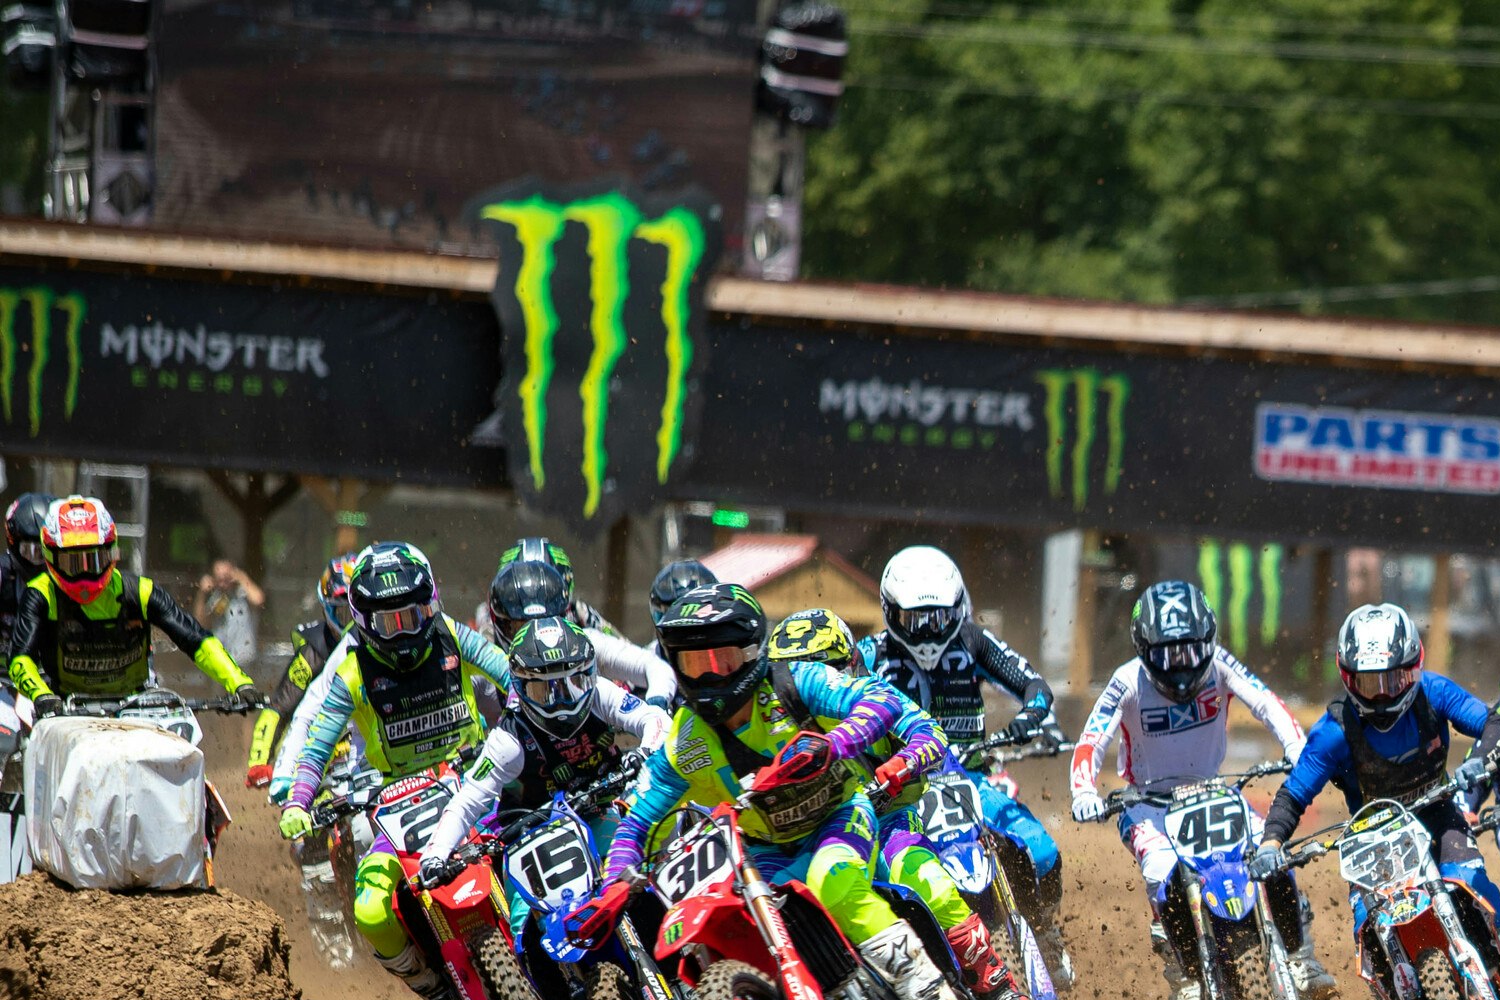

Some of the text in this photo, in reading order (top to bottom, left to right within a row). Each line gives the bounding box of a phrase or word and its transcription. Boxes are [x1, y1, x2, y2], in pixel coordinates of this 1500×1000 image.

[101, 321, 329, 378] MONSTER
[819, 376, 1034, 432] MONSTER
[388, 702, 469, 738] CHAMPIONSHIP
[1140, 687, 1220, 733] FXR
[918, 777, 977, 838] 29
[1177, 801, 1246, 848] 45
[520, 829, 588, 900] 15
[667, 834, 729, 904] 30
